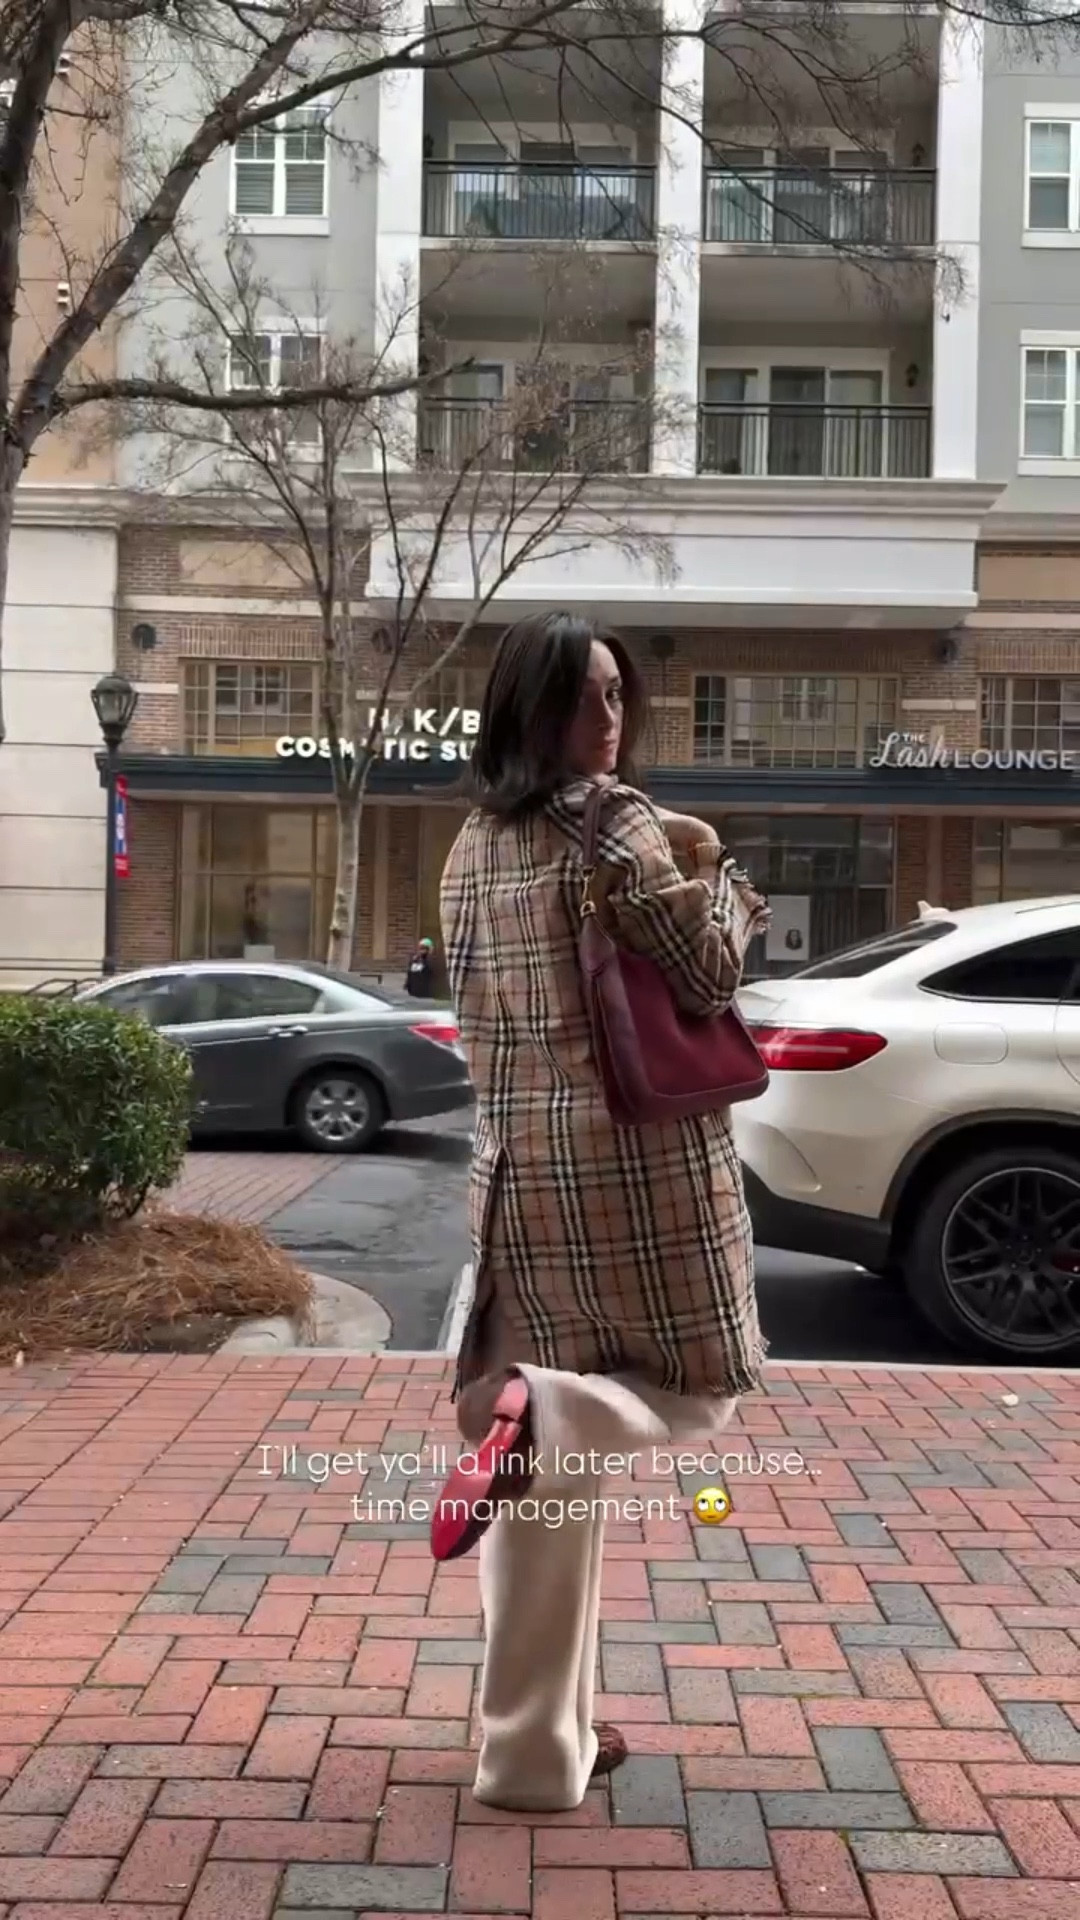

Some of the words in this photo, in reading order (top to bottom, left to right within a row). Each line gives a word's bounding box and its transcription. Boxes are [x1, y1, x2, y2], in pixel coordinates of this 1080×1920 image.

[275, 735, 431, 761] COSMTIC
[869, 731, 950, 768] Lash
[953, 748, 1075, 770] LOUNGE
[902, 732, 926, 743] THE
